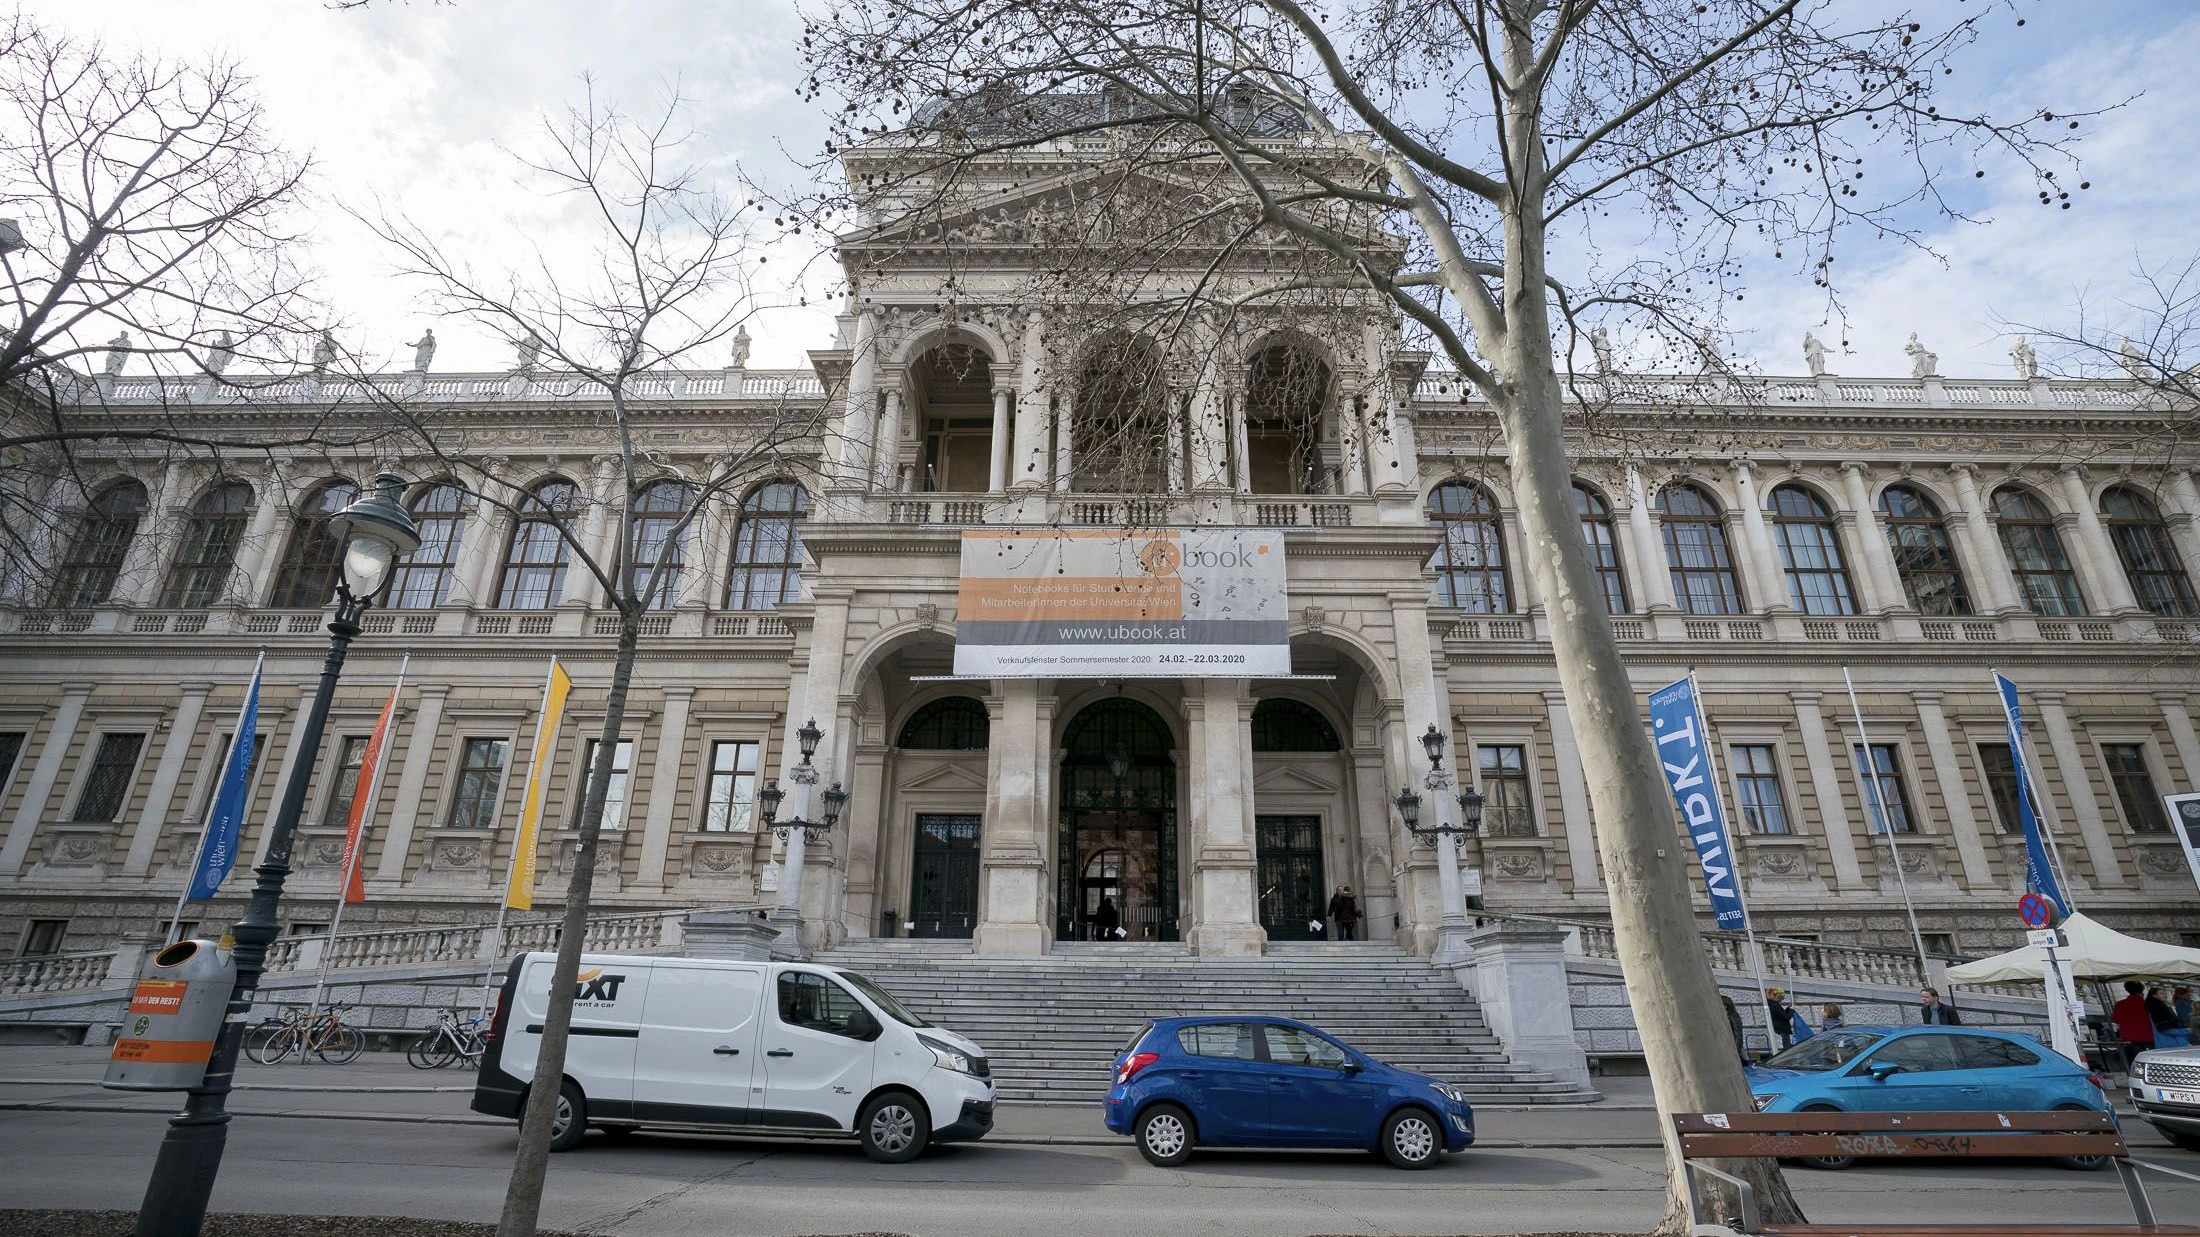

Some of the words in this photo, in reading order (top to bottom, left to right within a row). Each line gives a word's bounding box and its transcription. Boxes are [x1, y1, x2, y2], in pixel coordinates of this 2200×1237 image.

[1013, 584, 1069, 594] Notebooks
[1072, 583, 1088, 594] für
[1156, 584, 1176, 593] und
[981, 598, 1066, 608] MitarbeiterInnen
[1069, 598, 1086, 607] der
[1149, 598, 1177, 608] Wien
[1058, 625, 1187, 640] www.ubook.at
[997, 656, 1058, 665] Verkaufsfenster
[1059, 656, 1130, 664] Sommersemester
[1131, 656, 1153, 664] 2020:
[159, 997, 180, 1006] REST!
